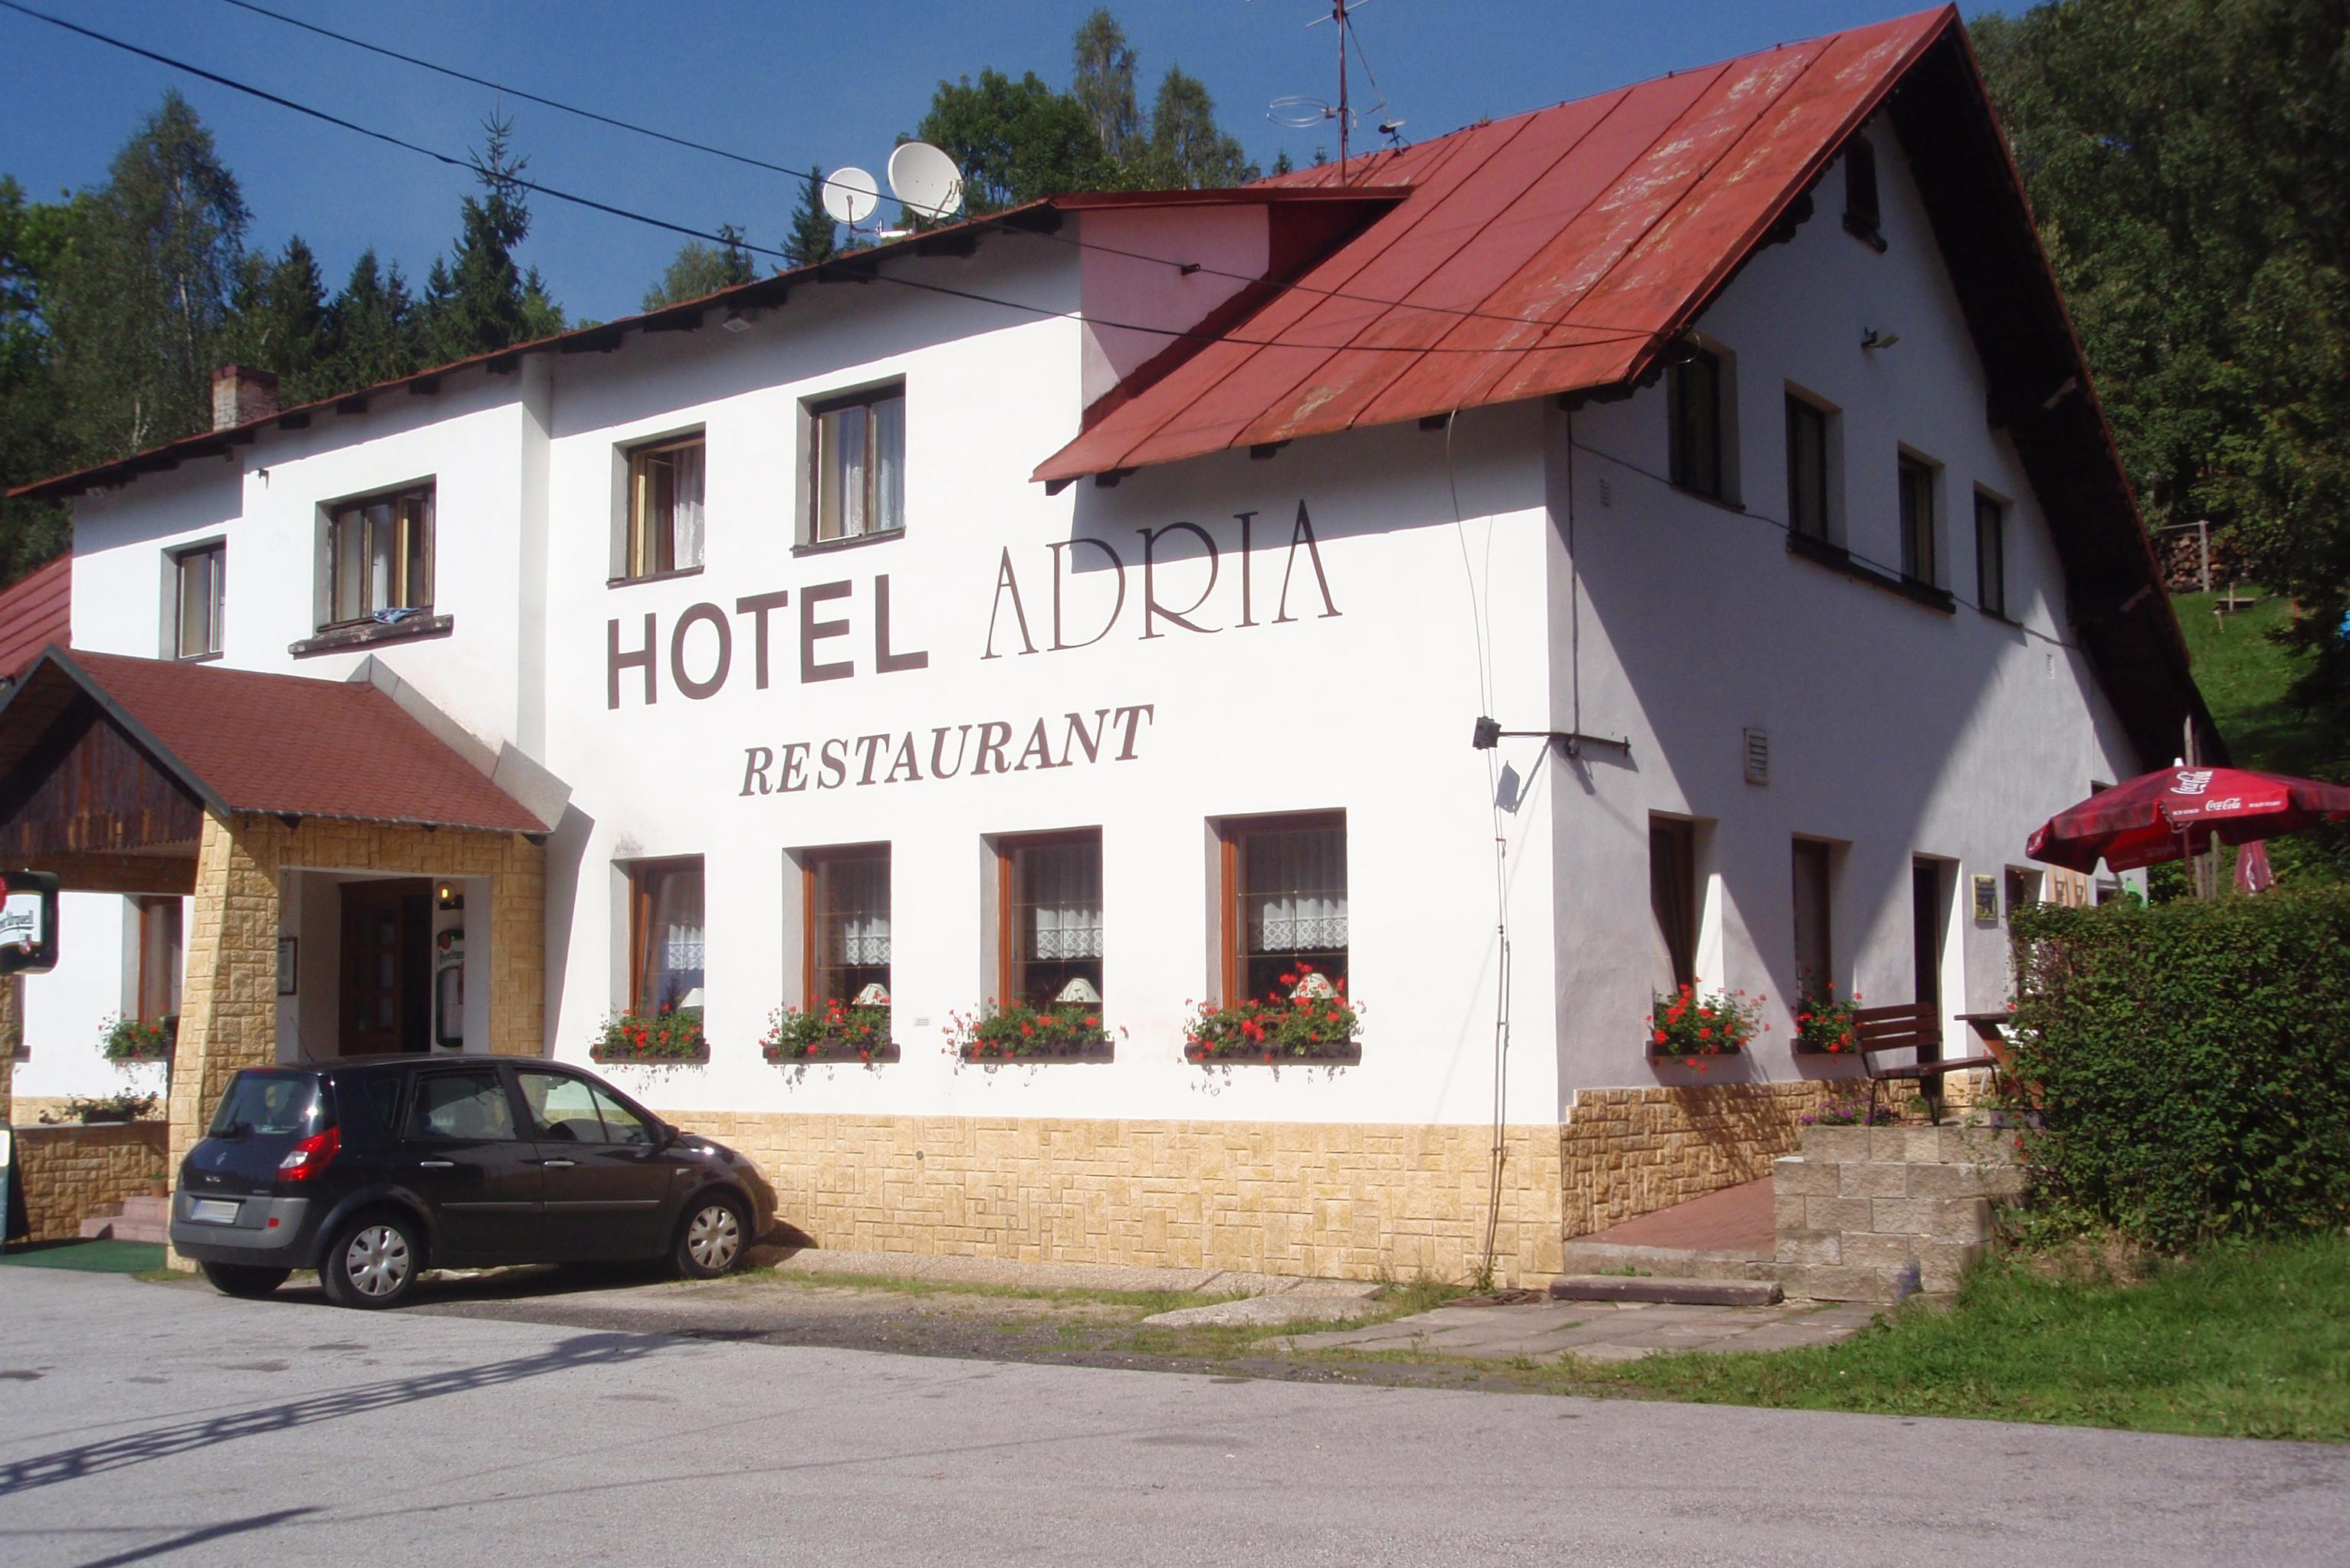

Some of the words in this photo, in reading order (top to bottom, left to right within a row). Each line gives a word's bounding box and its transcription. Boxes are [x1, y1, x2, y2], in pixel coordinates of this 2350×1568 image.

[607, 574, 928, 710] HOTEL
[980, 499, 1343, 661] ADRIA
[738, 704, 1155, 797] RESTAURANT
